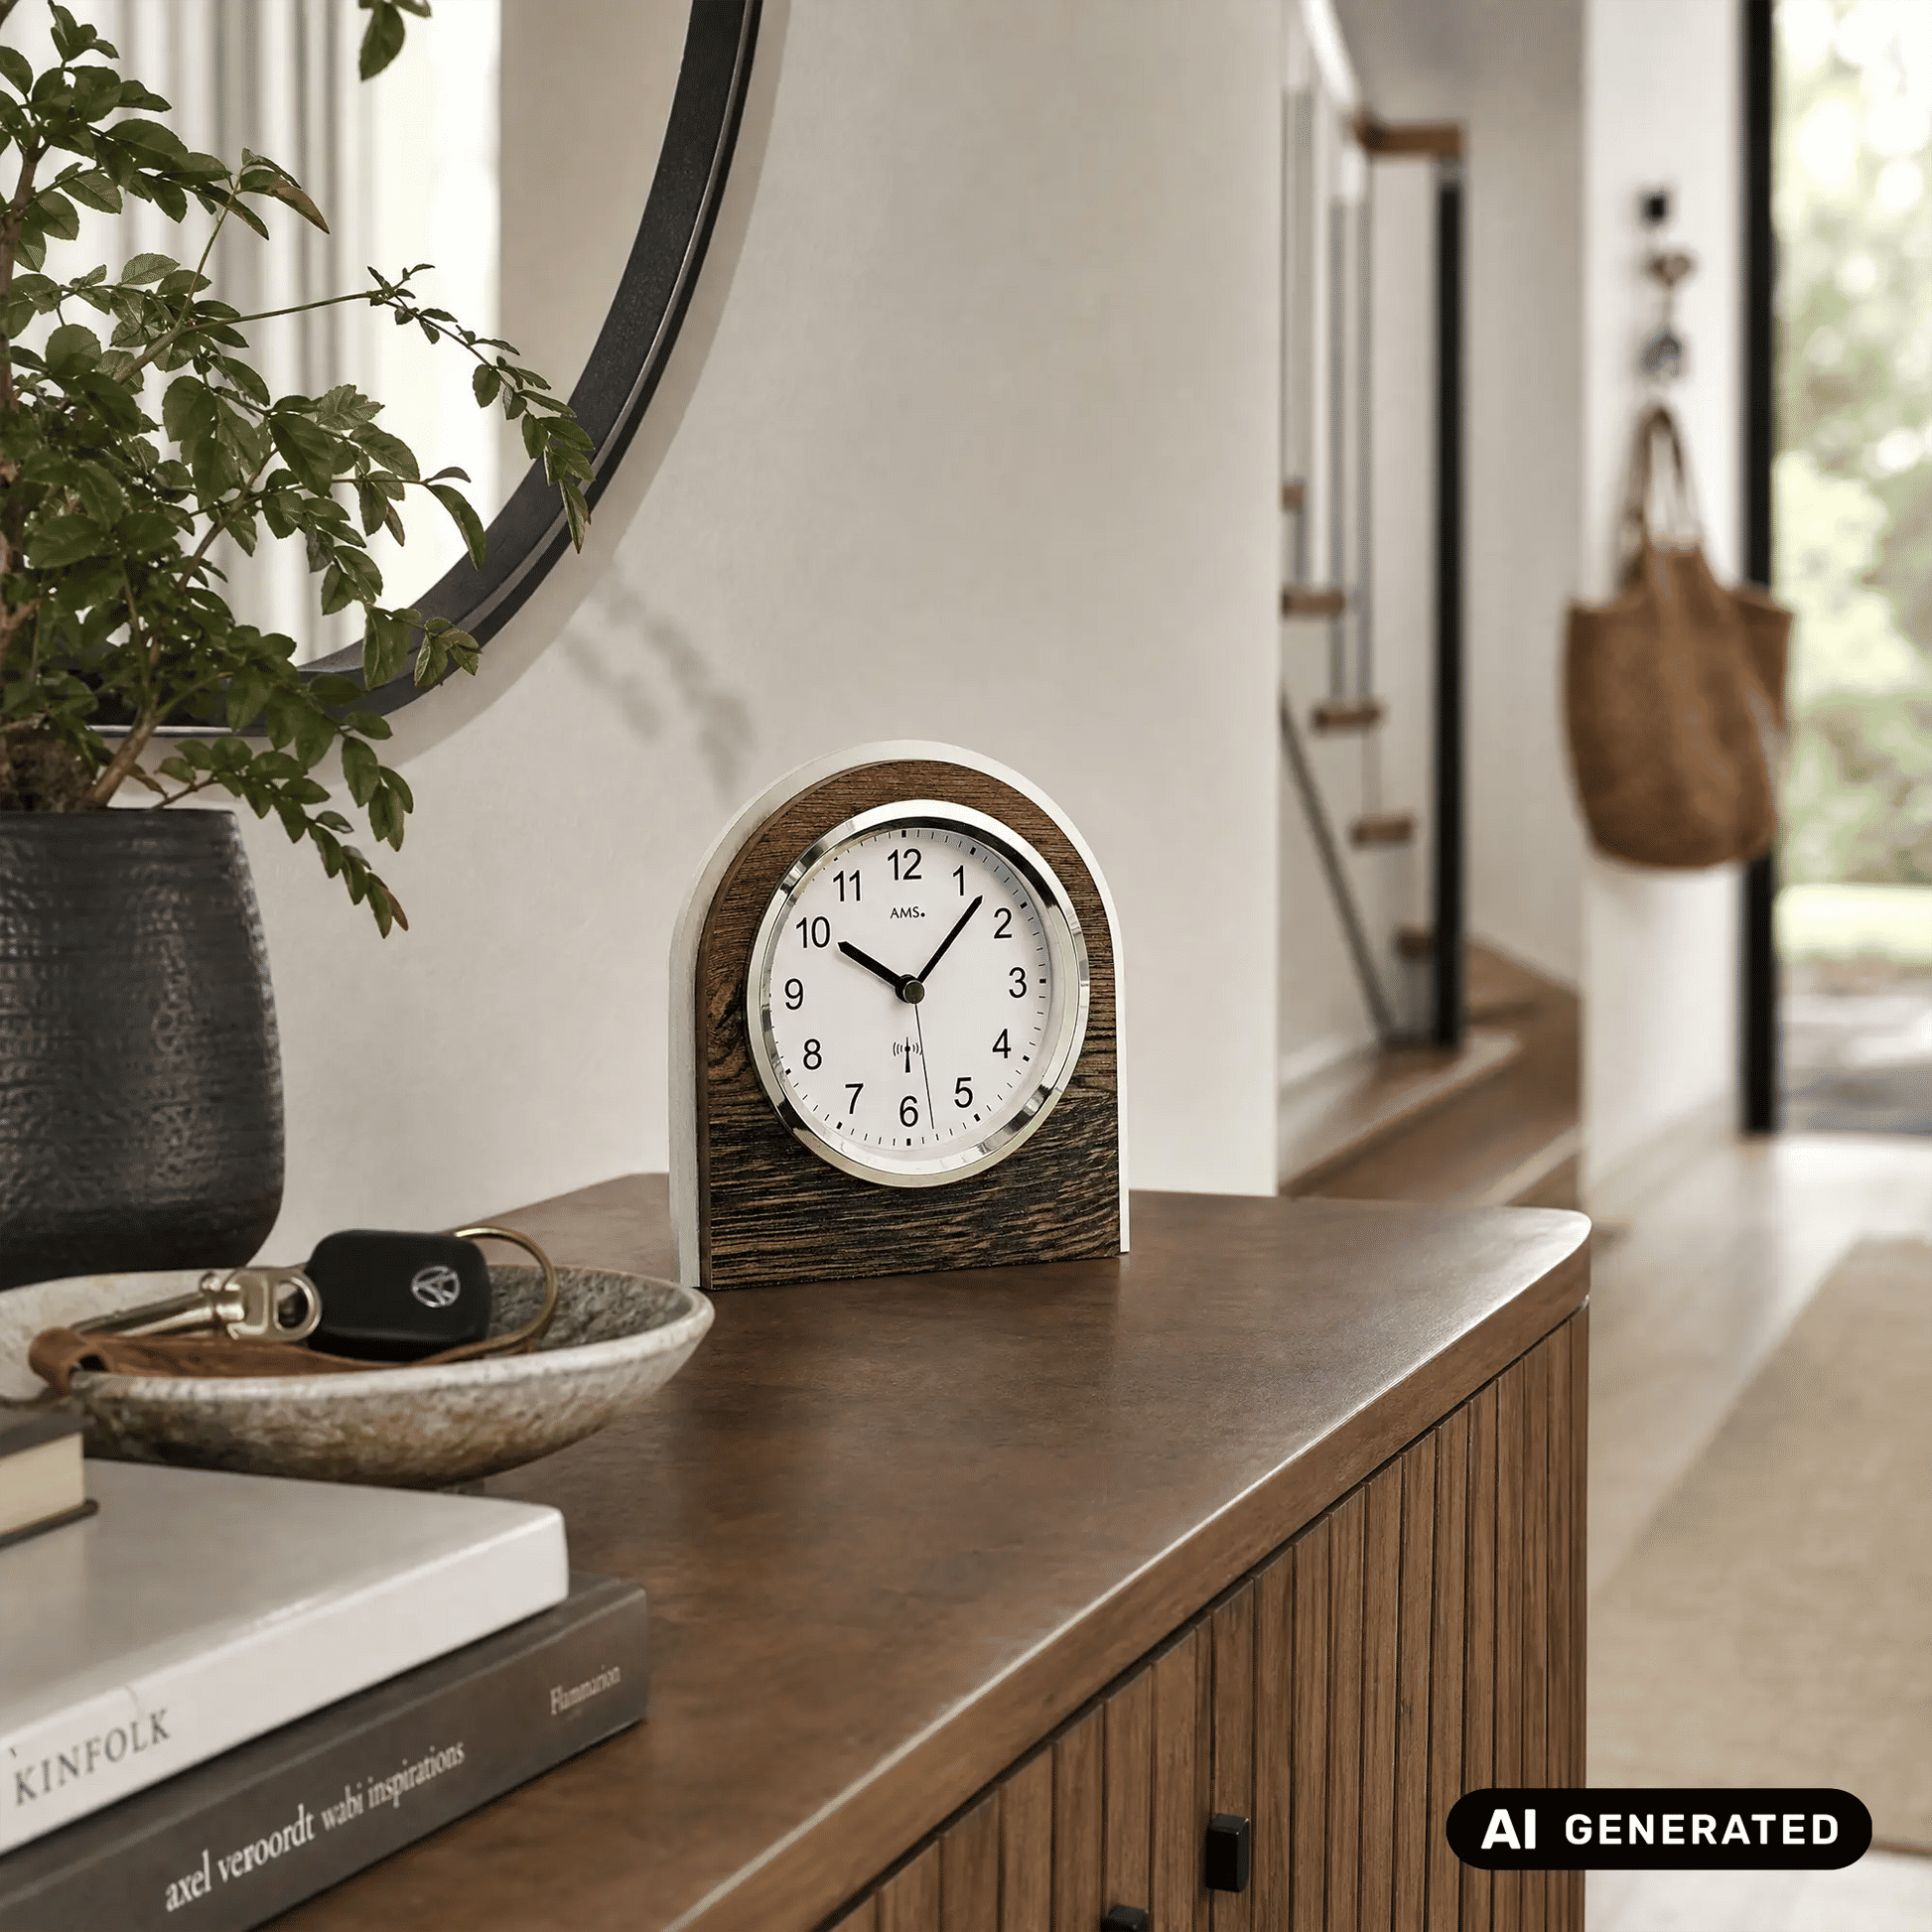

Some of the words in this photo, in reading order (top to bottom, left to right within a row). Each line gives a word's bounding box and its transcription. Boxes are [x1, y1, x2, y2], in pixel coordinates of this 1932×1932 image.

[887, 848, 922, 882] 12
[952, 864, 965, 897] 1
[832, 869, 862, 902] 11
[795, 915, 831, 949] 10
[993, 906, 1013, 940] 2
[784, 977, 804, 1011] 9
[1008, 966, 1028, 999] 3
[802, 1037, 823, 1071] 8
[992, 1028, 1012, 1059] 4
[844, 1082, 865, 1115] 7
[953, 1076, 974, 1109] 5
[898, 1095, 919, 1128] 6
[15, 1707, 170, 1805] KINFOLK
[165, 1848, 211, 1912] axel
[216, 1802, 316, 1883] veroordt
[321, 1782, 364, 1832] wabi
[367, 1740, 466, 1809] inspirations
